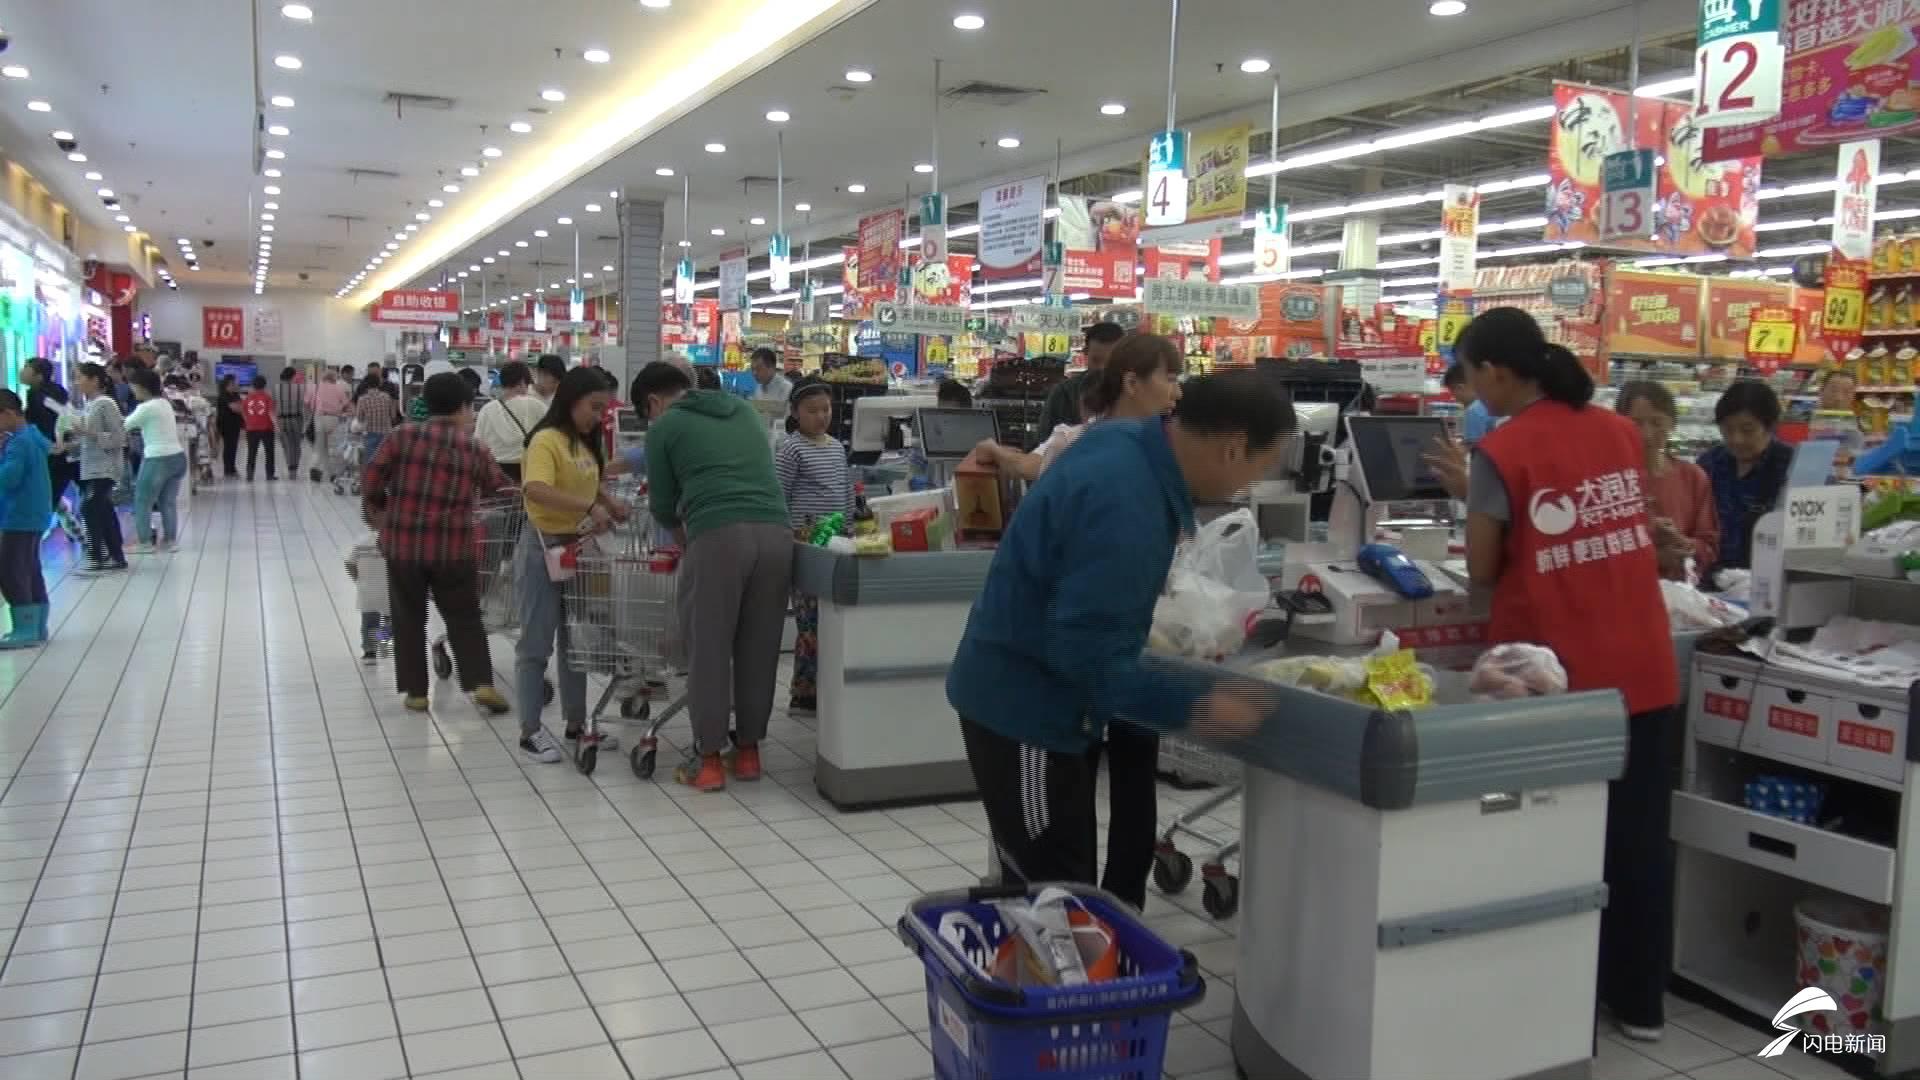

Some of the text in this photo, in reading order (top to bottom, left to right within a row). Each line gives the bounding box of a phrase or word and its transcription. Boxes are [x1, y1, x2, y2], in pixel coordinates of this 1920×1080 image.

[1696, 41, 1758, 116] 12
[1152, 176, 1170, 216] 4
[1604, 191, 1642, 234] 13
[1263, 246, 1278, 268] 5
[392, 294, 447, 309] 自助收银
[208, 321, 234, 341] 10
[1755, 329, 1769, 350] 7
[1576, 469, 1641, 510] 大润发
[1536, 543, 1571, 576] 新鲜
